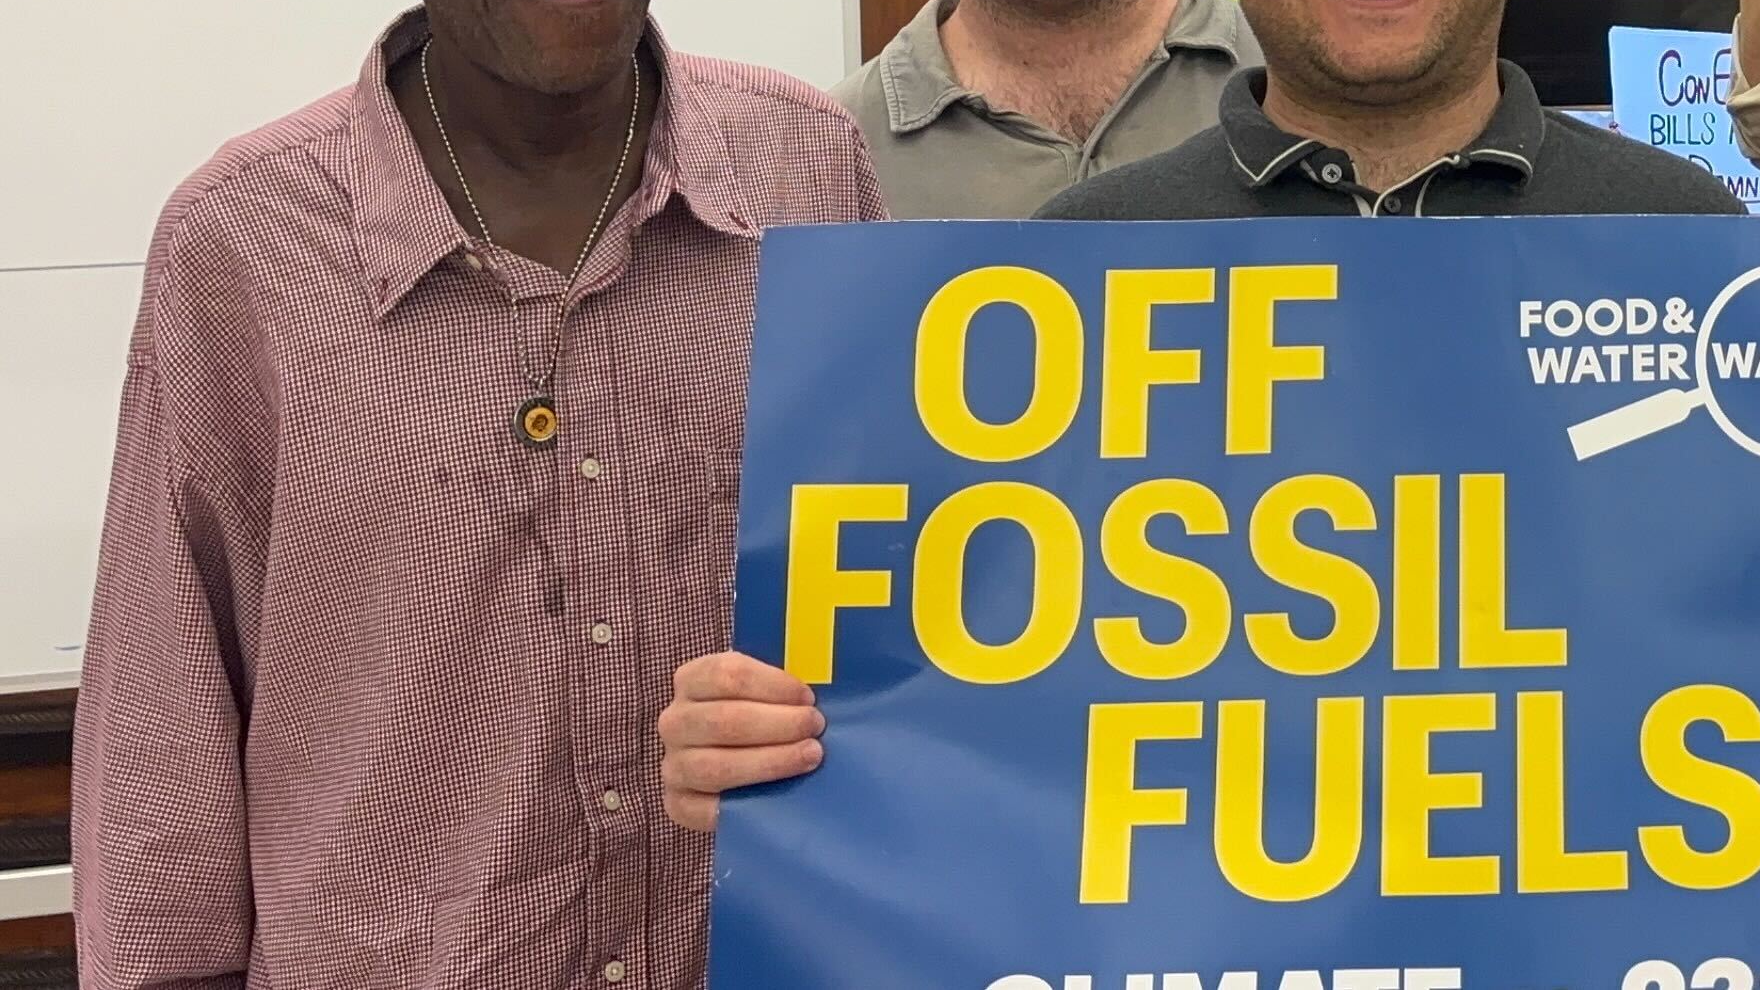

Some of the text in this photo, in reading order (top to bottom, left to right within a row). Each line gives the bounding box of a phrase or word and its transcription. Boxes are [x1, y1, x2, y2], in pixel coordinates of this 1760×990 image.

[1650, 111, 1716, 146] BILLS
[914, 264, 1338, 464] OFF
[1527, 343, 1691, 385] WATER
[781, 473, 1567, 687] FOSSIL
